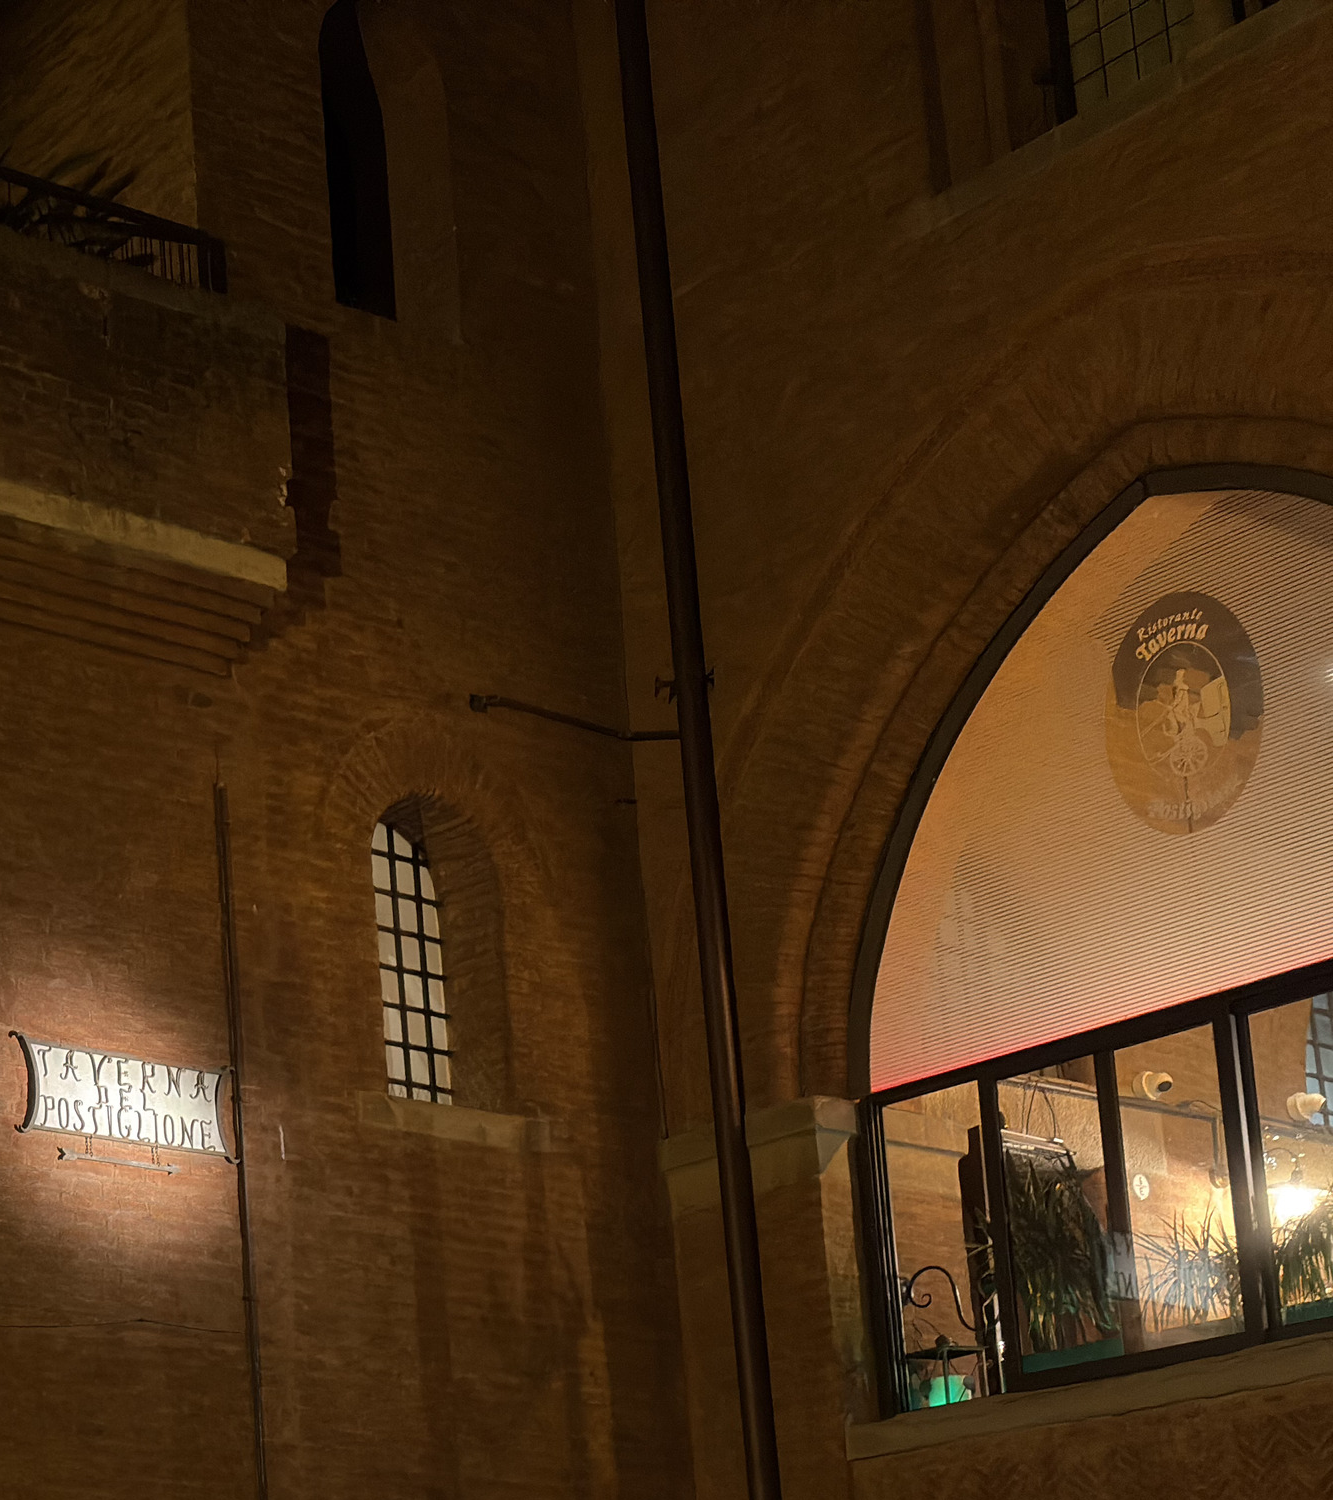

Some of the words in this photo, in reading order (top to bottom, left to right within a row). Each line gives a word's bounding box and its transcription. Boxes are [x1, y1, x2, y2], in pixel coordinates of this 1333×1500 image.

[1135, 623, 1210, 662] Taverna
[37, 1046, 212, 1102] TAVERNA
[96, 1083, 156, 1113] DEL
[39, 1094, 217, 1150] POSTIGLIONE
